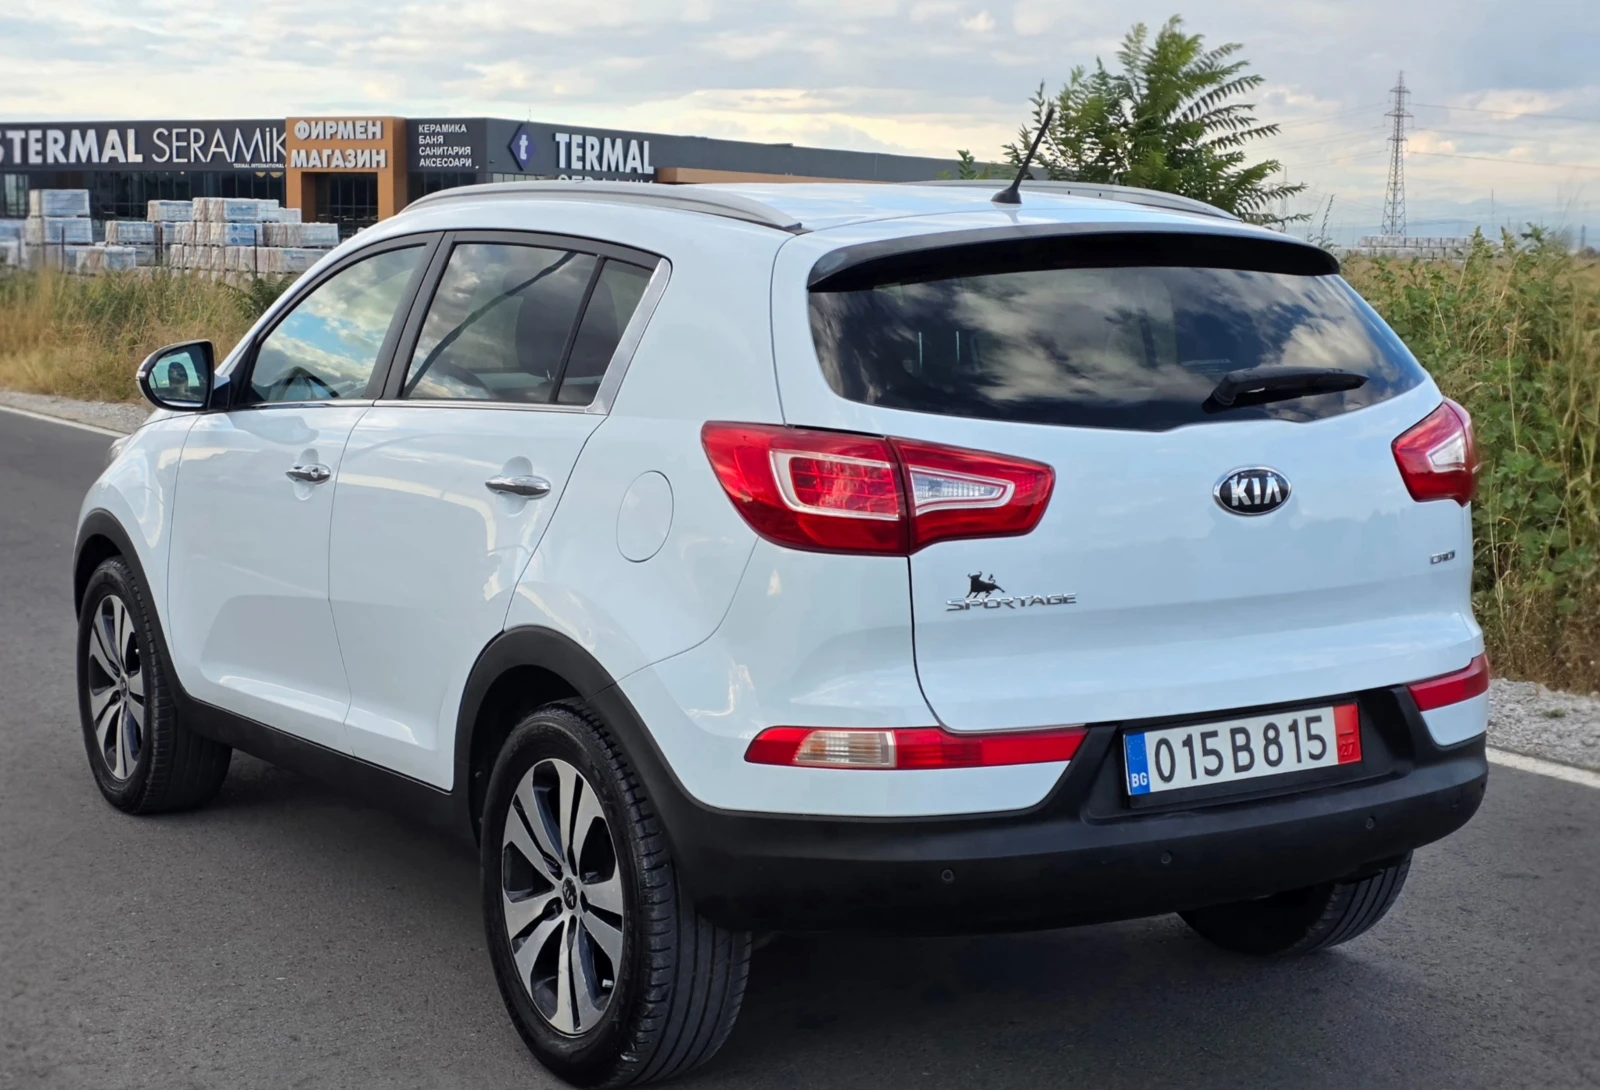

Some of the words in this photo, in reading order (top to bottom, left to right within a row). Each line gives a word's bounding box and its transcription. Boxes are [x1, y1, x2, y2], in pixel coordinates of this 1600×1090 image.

[294, 120, 383, 140] ФИРМЕН
[418, 124, 468, 133] КЕРАМИКА
[418, 135, 444, 145] БАНЯ
[290, 148, 387, 169] МАГАЗИН
[419, 146, 471, 156] САНИТАРИЯ
[555, 132, 654, 175] TERMAL
[419, 157, 472, 168] АКСЕСОАРИ
[1228, 475, 1282, 507] KIA
[946, 592, 1078, 612] SPORTAGE
[1131, 772, 1148, 788] BG
